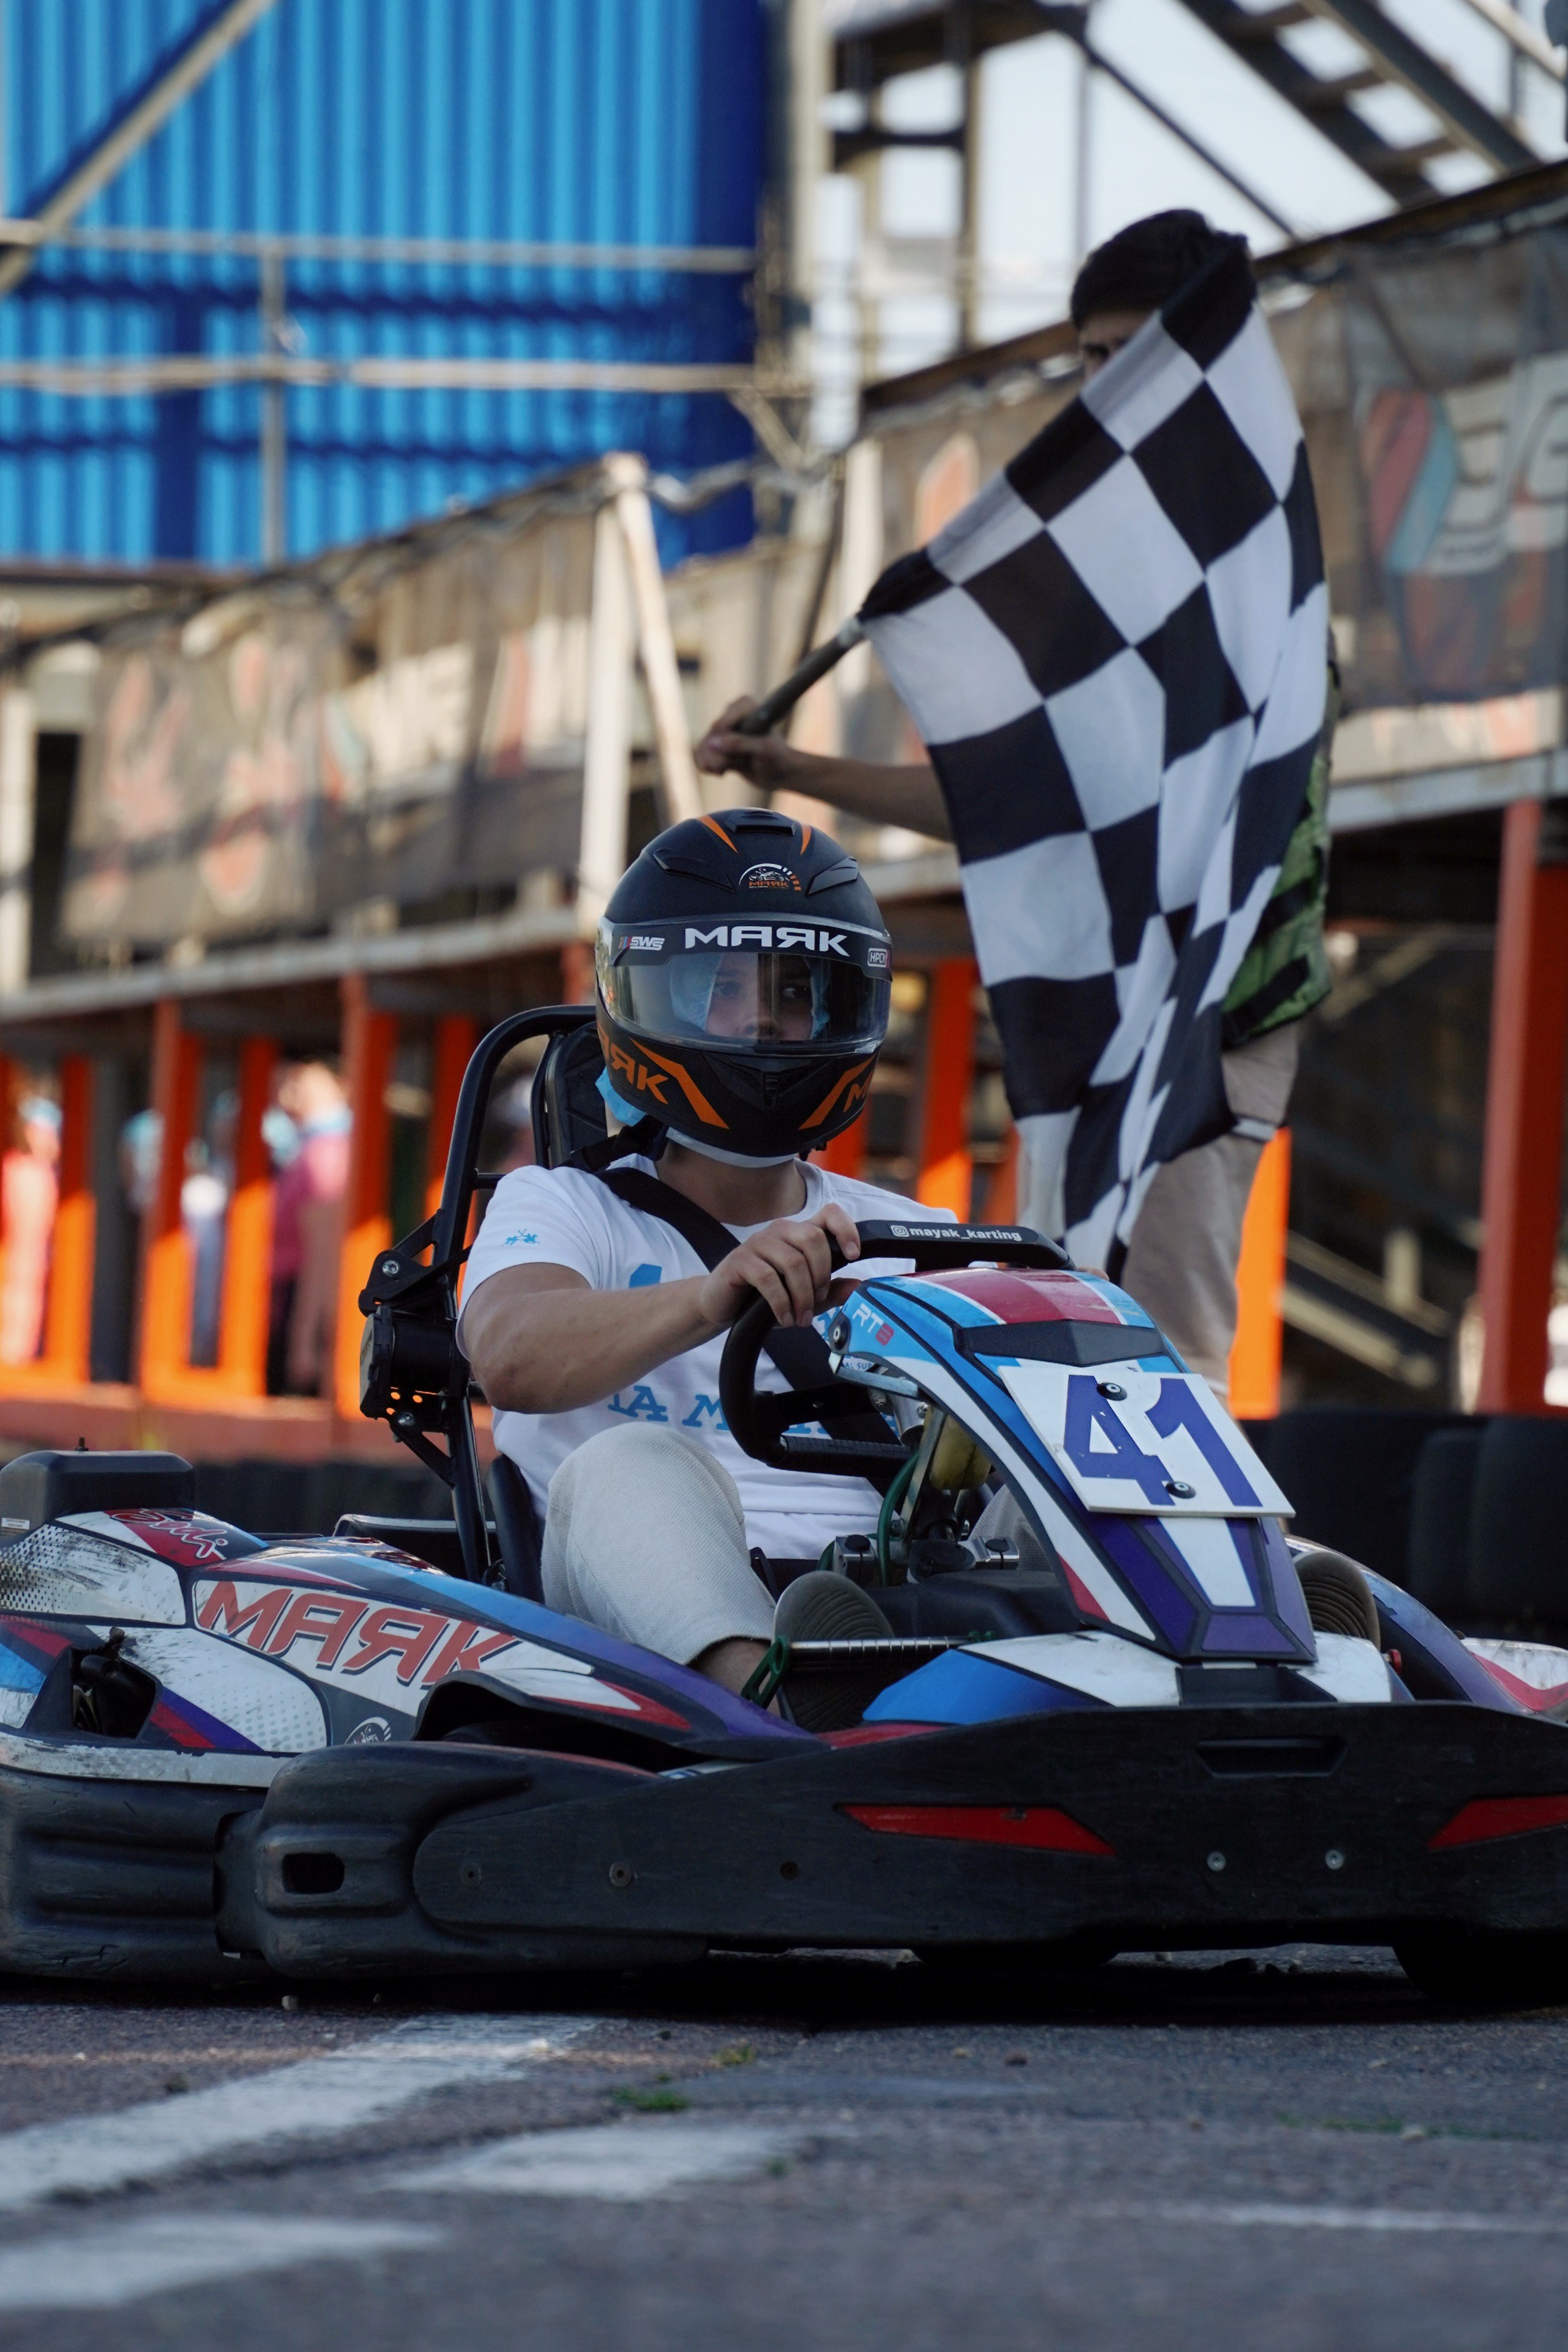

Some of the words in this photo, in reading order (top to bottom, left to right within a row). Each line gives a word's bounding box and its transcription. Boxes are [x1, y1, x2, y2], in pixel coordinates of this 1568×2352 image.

[630, 936, 665, 951] SWS
[685, 926, 850, 957] МАЯК
[909, 1227, 1022, 1241] mayak_karting
[1063, 1374, 1264, 1507] 41
[198, 1580, 522, 1689] МАЯК
